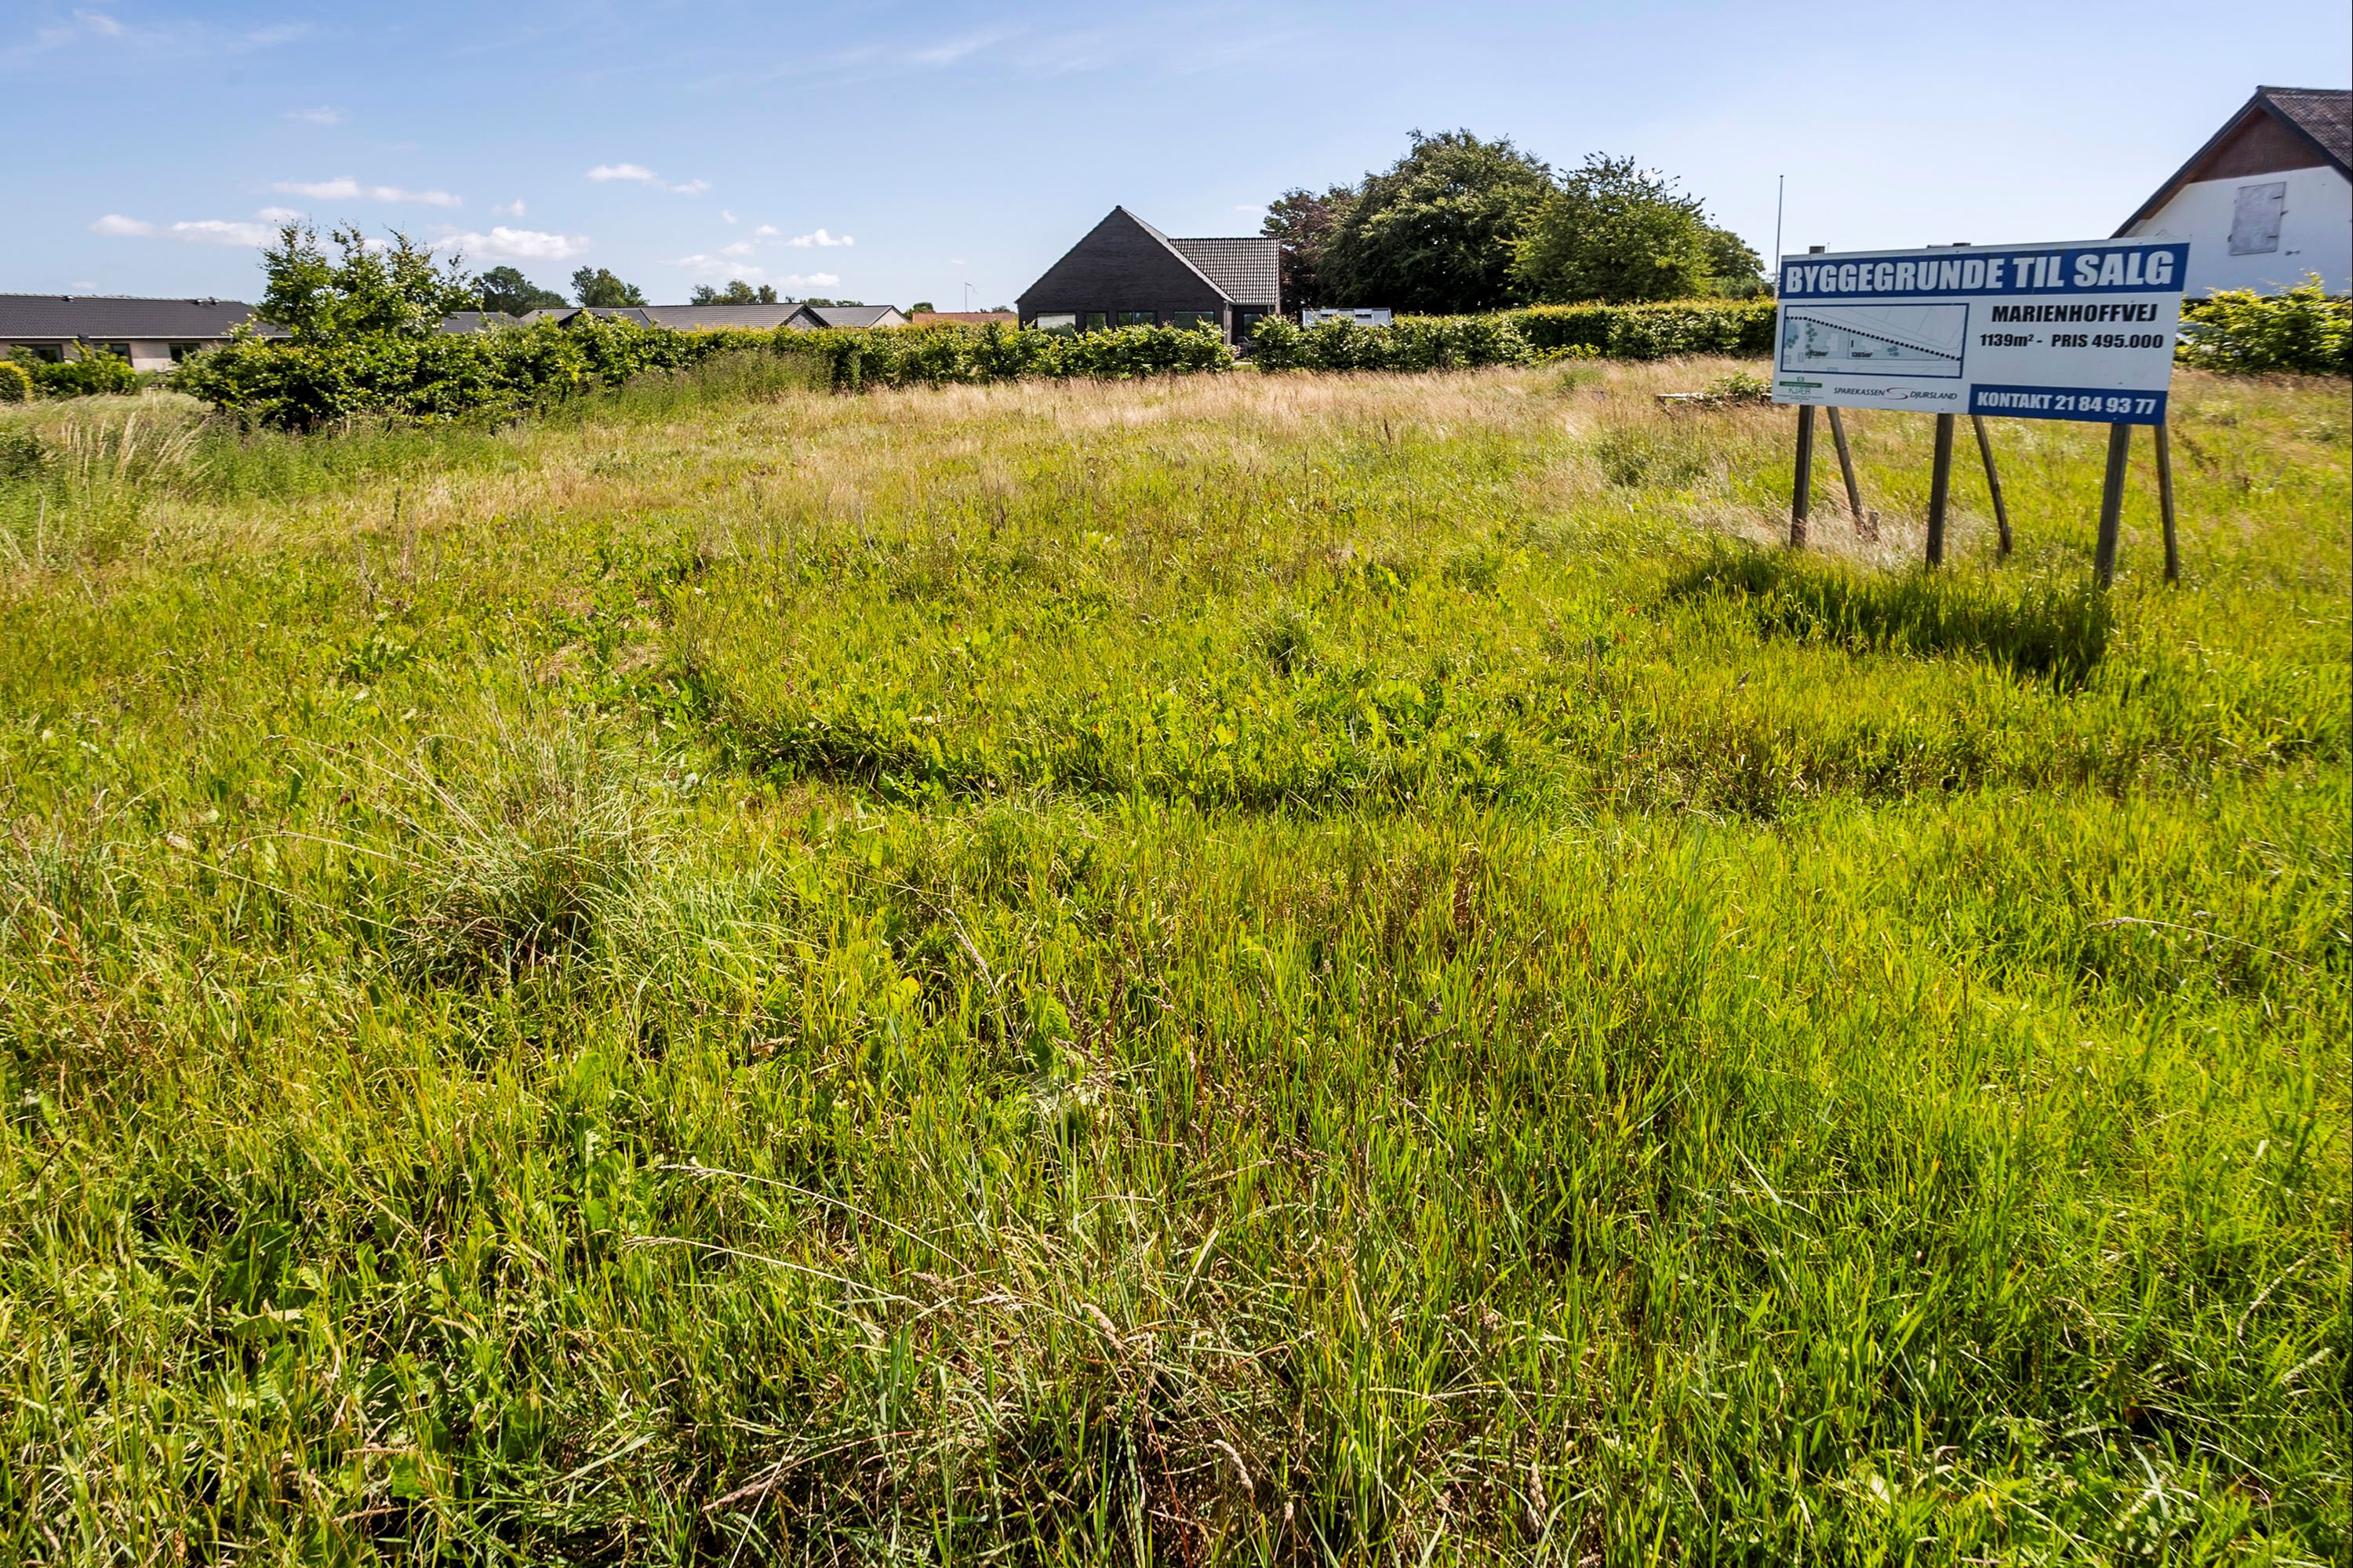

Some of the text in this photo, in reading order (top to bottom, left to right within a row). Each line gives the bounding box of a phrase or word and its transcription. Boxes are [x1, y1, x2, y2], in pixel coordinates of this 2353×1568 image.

[1785, 250, 2174, 293] BYGGEGRUNDE TIL SALG
[1991, 304, 2158, 322] MARIENHOFFVEJ
[1980, 333, 2035, 347] 1139m²
[2051, 334, 2088, 347] PRIS
[2091, 334, 2164, 348] 495.000
[1833, 387, 1958, 400] SPAREKASSEN DJURSLAND
[1977, 391, 2156, 415] KONTAKT 21 84 93 77
